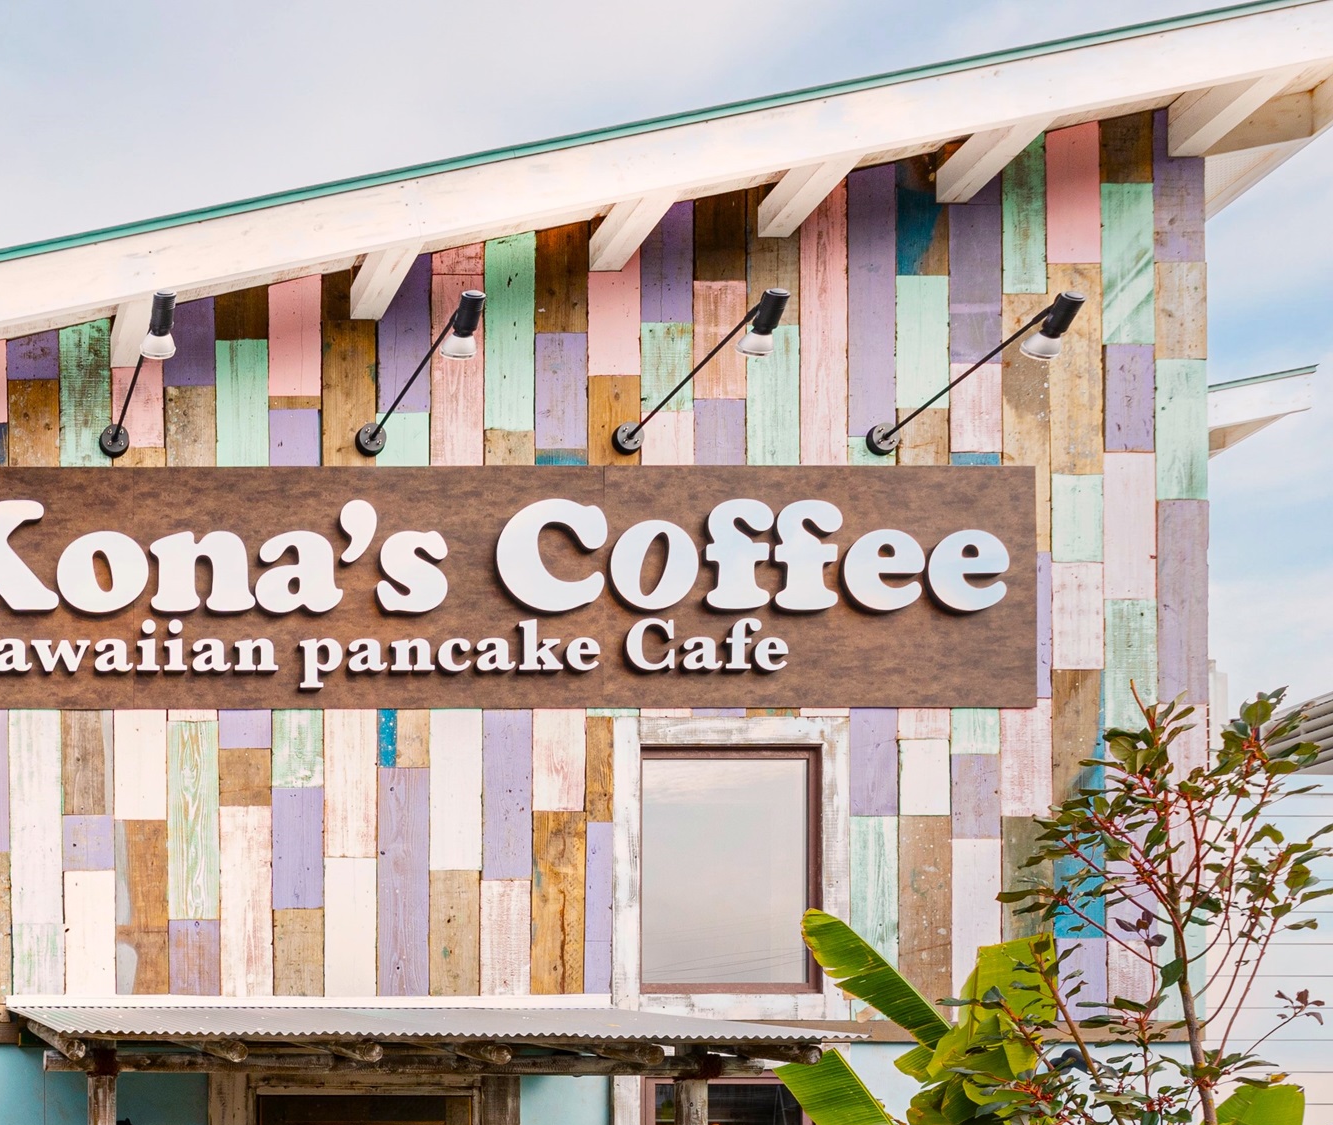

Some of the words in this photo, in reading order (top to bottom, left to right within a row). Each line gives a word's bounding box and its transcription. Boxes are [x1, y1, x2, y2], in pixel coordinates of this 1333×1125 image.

[496, 497, 1011, 613] Coffee
[299, 617, 601, 689] pancake
[626, 617, 790, 673] Cafe
